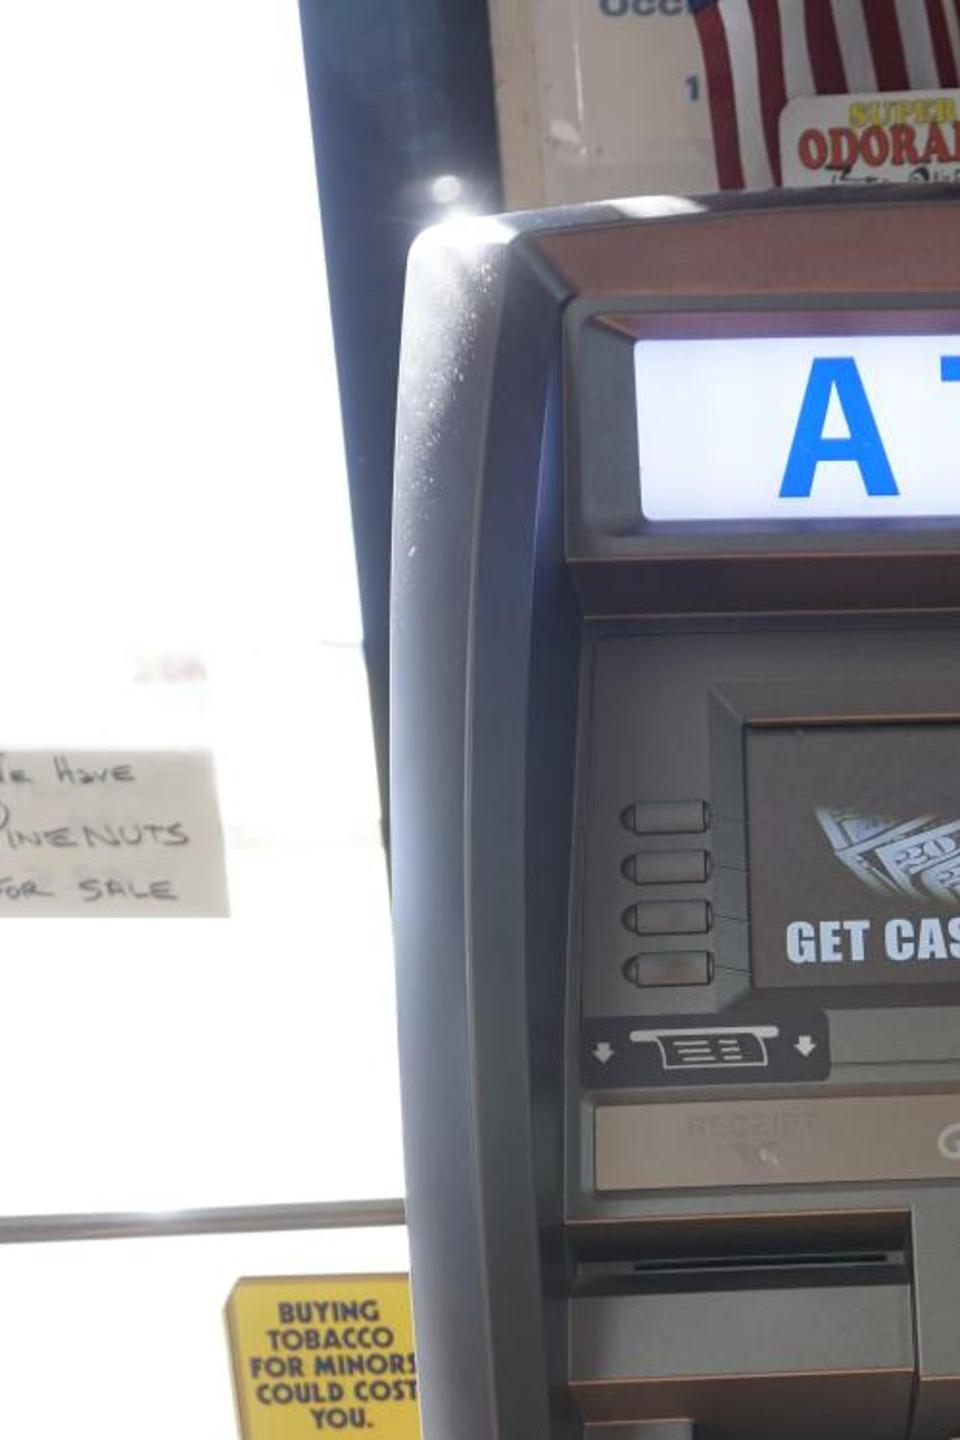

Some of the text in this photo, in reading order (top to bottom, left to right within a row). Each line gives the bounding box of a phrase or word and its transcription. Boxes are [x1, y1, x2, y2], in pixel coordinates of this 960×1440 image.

[849, 97, 957, 128] SUPER
[78, 877, 180, 903] SALE
[786, 919, 871, 964] GET
[277, 1300, 380, 1324] BUYING
[266, 1327, 394, 1351] TOBACCO
[251, 1355, 304, 1378] FOR
[256, 1380, 418, 1405] COULD COST
[310, 1407, 375, 1430] YOU.
